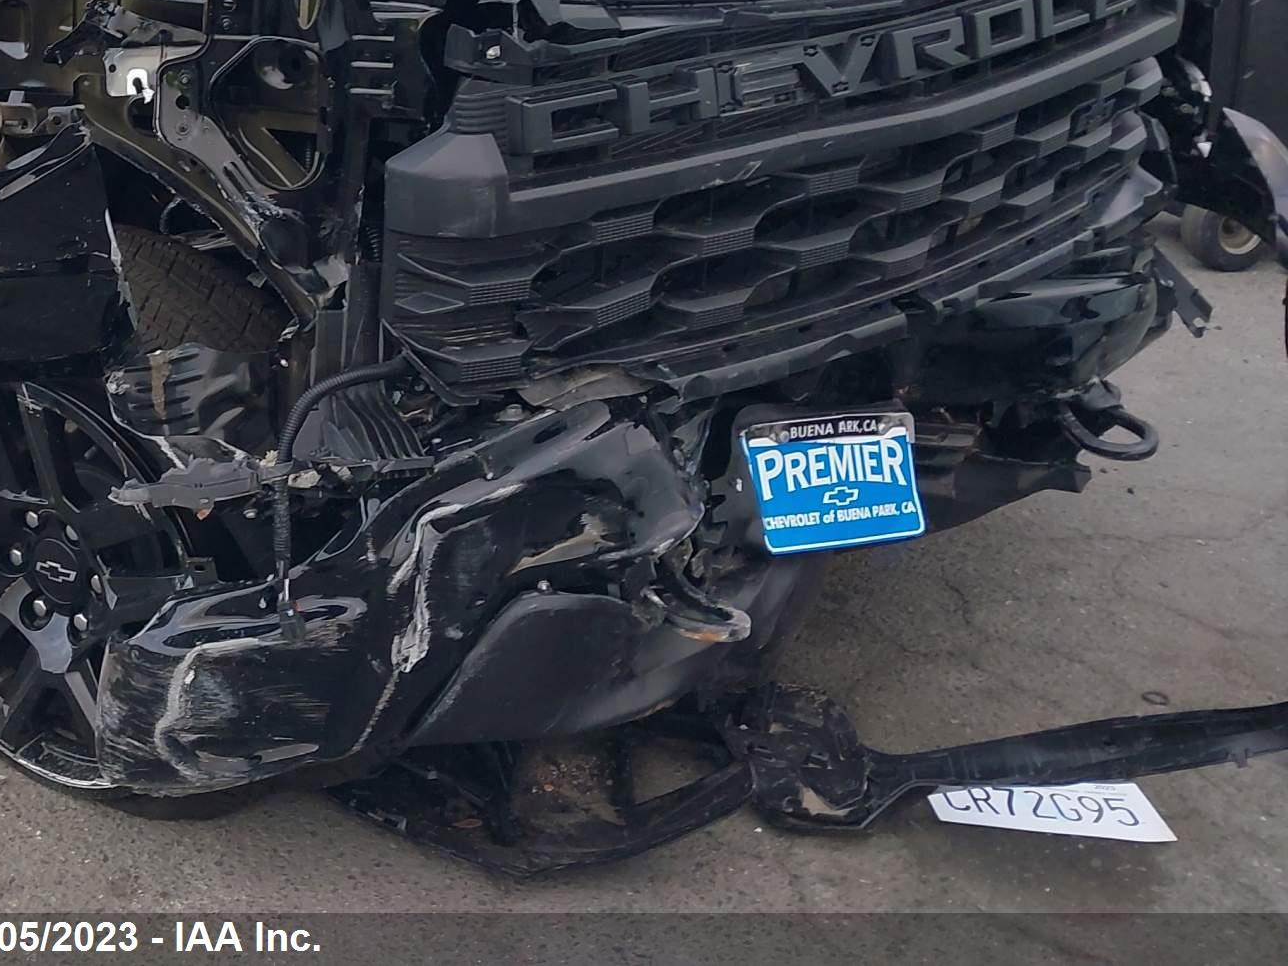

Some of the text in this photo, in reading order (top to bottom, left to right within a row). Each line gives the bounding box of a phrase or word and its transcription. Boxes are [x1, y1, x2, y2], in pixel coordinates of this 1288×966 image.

[790, 423, 834, 438] BUENA
[756, 440, 907, 501] PREMIER
[763, 501, 916, 531] CHEVROLET of BUENA PARK, CA
